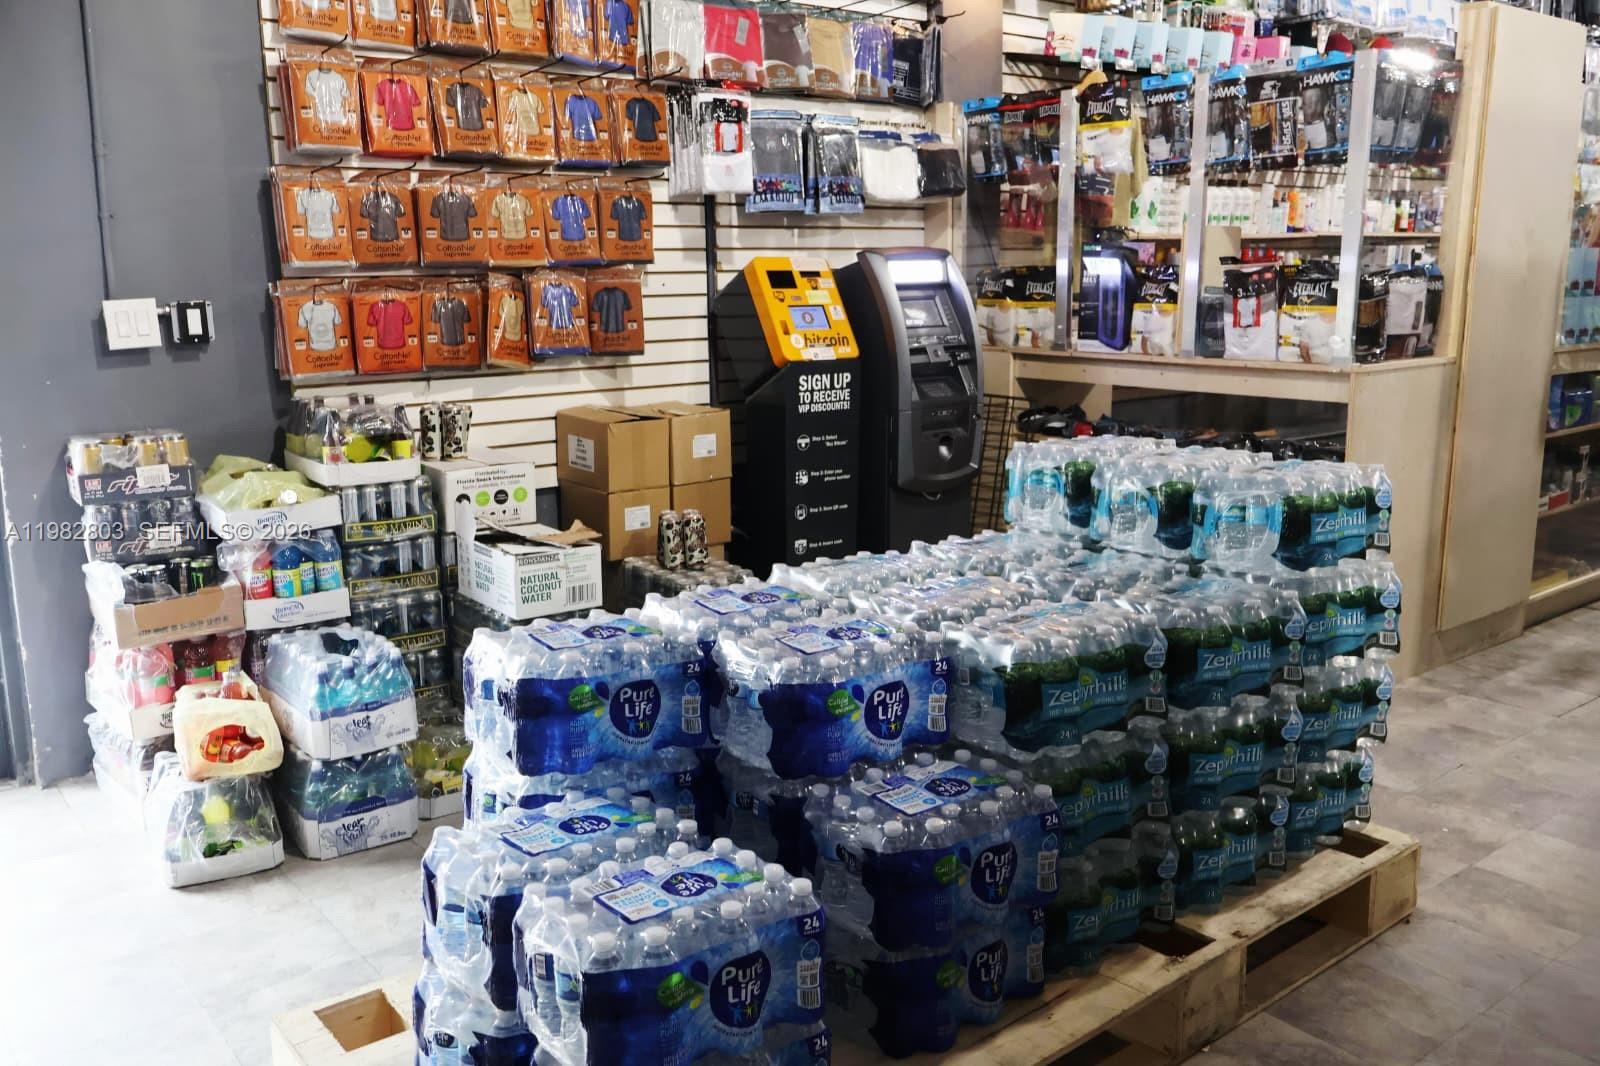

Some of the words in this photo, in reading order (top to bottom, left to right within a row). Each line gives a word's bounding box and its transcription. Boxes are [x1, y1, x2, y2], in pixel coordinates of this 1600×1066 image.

[1304, 71, 1339, 87] HAWK
[1087, 99, 1114, 115] EVERLAST
[1026, 281, 1054, 295] EVERLAST
[1292, 281, 1329, 298] EVERLAST
[804, 333, 850, 348] bitcoin
[799, 373, 831, 391] SIGN
[834, 372, 851, 388] UP
[799, 391, 811, 404] TO
[813, 389, 851, 403] RECEIVE
[798, 404, 809, 413] VIP
[811, 401, 850, 412] DISCOUNTS!
[390, 520, 430, 534] MARINA
[474, 560, 493, 575] NATURAL
[475, 569, 495, 585] COCONUT
[520, 571, 560, 585] NATURAL
[520, 581, 562, 595] COCONUT
[521, 592, 552, 605] WATER
[401, 636, 440, 650] MARINA
[687, 663, 700, 673] 24
[936, 661, 948, 672] 24
[620, 686, 655, 702] Pure
[625, 701, 653, 719] Life
[678, 774, 691, 784] 24
[1045, 814, 1059, 825] 24
[1032, 908, 1045, 920] 24
[803, 916, 819, 929] 24
[721, 957, 763, 985] Pure
[728, 980, 760, 1004] Life
[814, 1036, 828, 1050] 24
